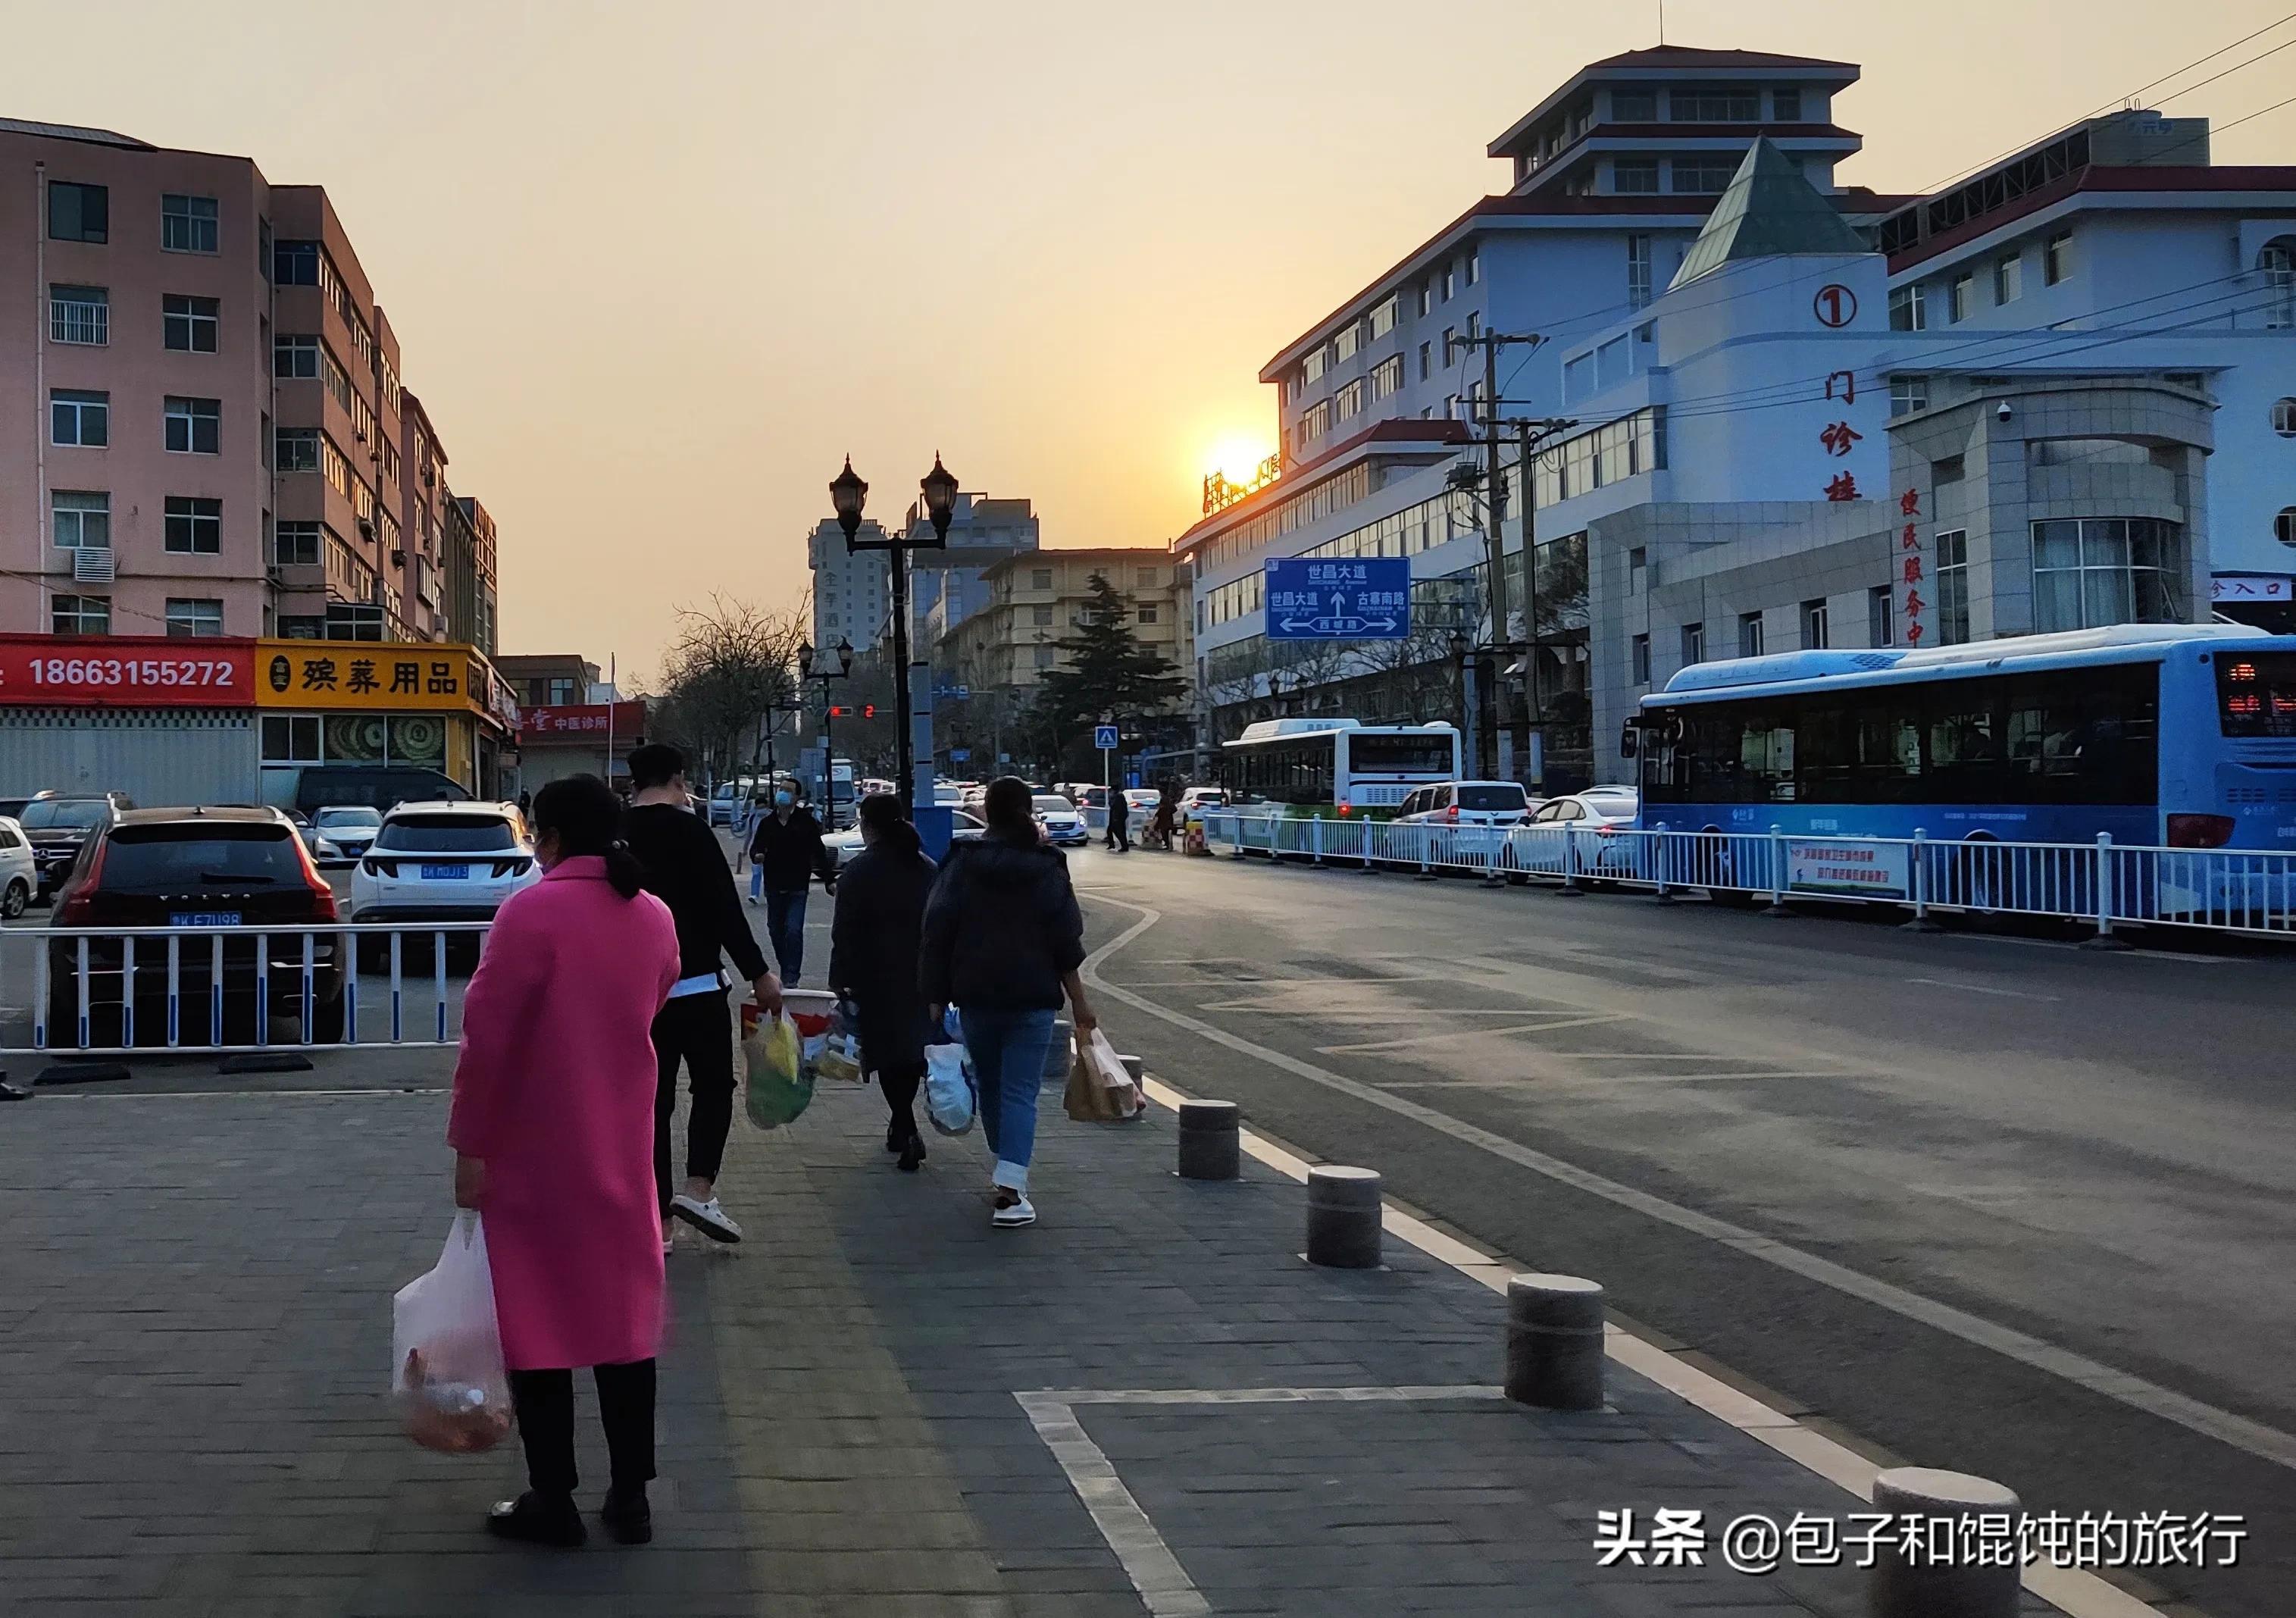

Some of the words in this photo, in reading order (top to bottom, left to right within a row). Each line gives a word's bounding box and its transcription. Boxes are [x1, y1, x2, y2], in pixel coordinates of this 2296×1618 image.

[1307, 564, 1367, 579] 世昌大道
[1271, 591, 1318, 606] 世昌大道
[1357, 591, 1404, 606] 古寨南路
[29, 659, 233, 686] 18663155272
[302, 657, 457, 695] 殡葬用品
[555, 714, 608, 731] 中医诊所
